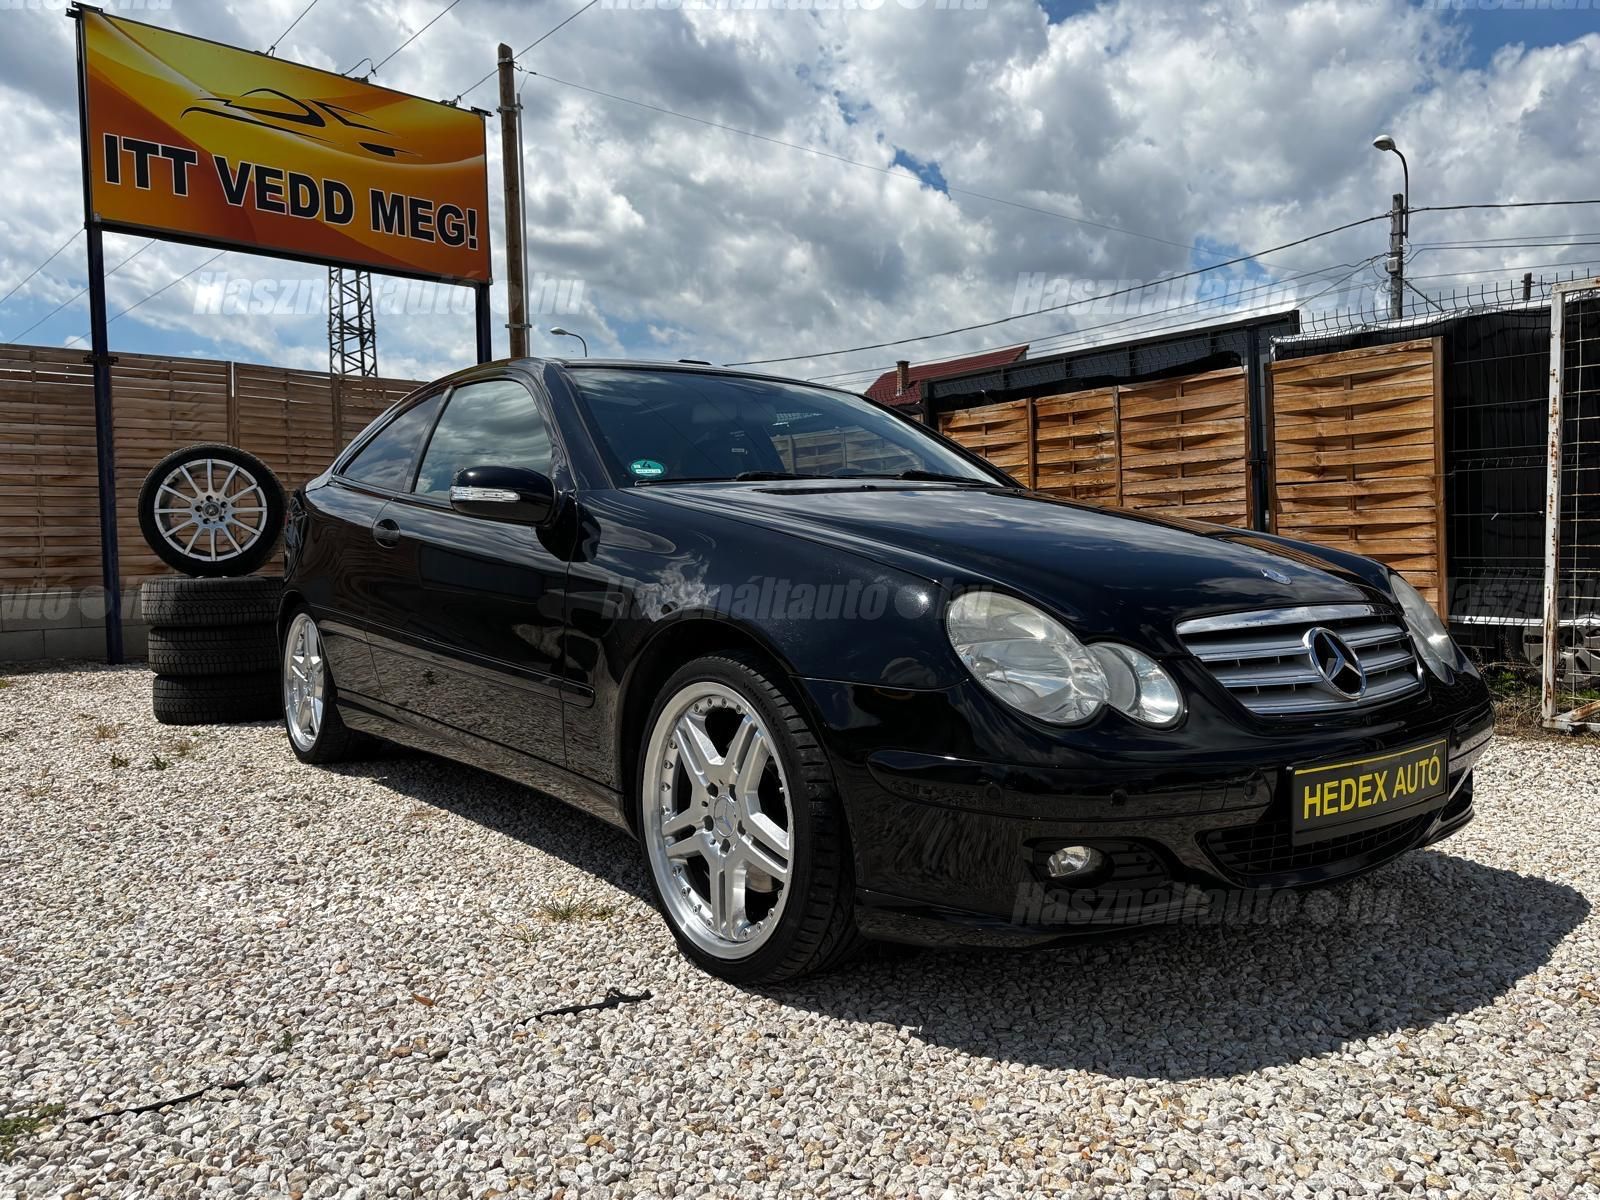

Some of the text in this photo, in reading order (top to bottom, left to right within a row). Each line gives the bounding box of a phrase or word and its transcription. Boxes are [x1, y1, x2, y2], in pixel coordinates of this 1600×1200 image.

[103, 132, 478, 250] ITT VEDD MEG!
[1304, 749, 1440, 820] HEDEX AUTÓ
